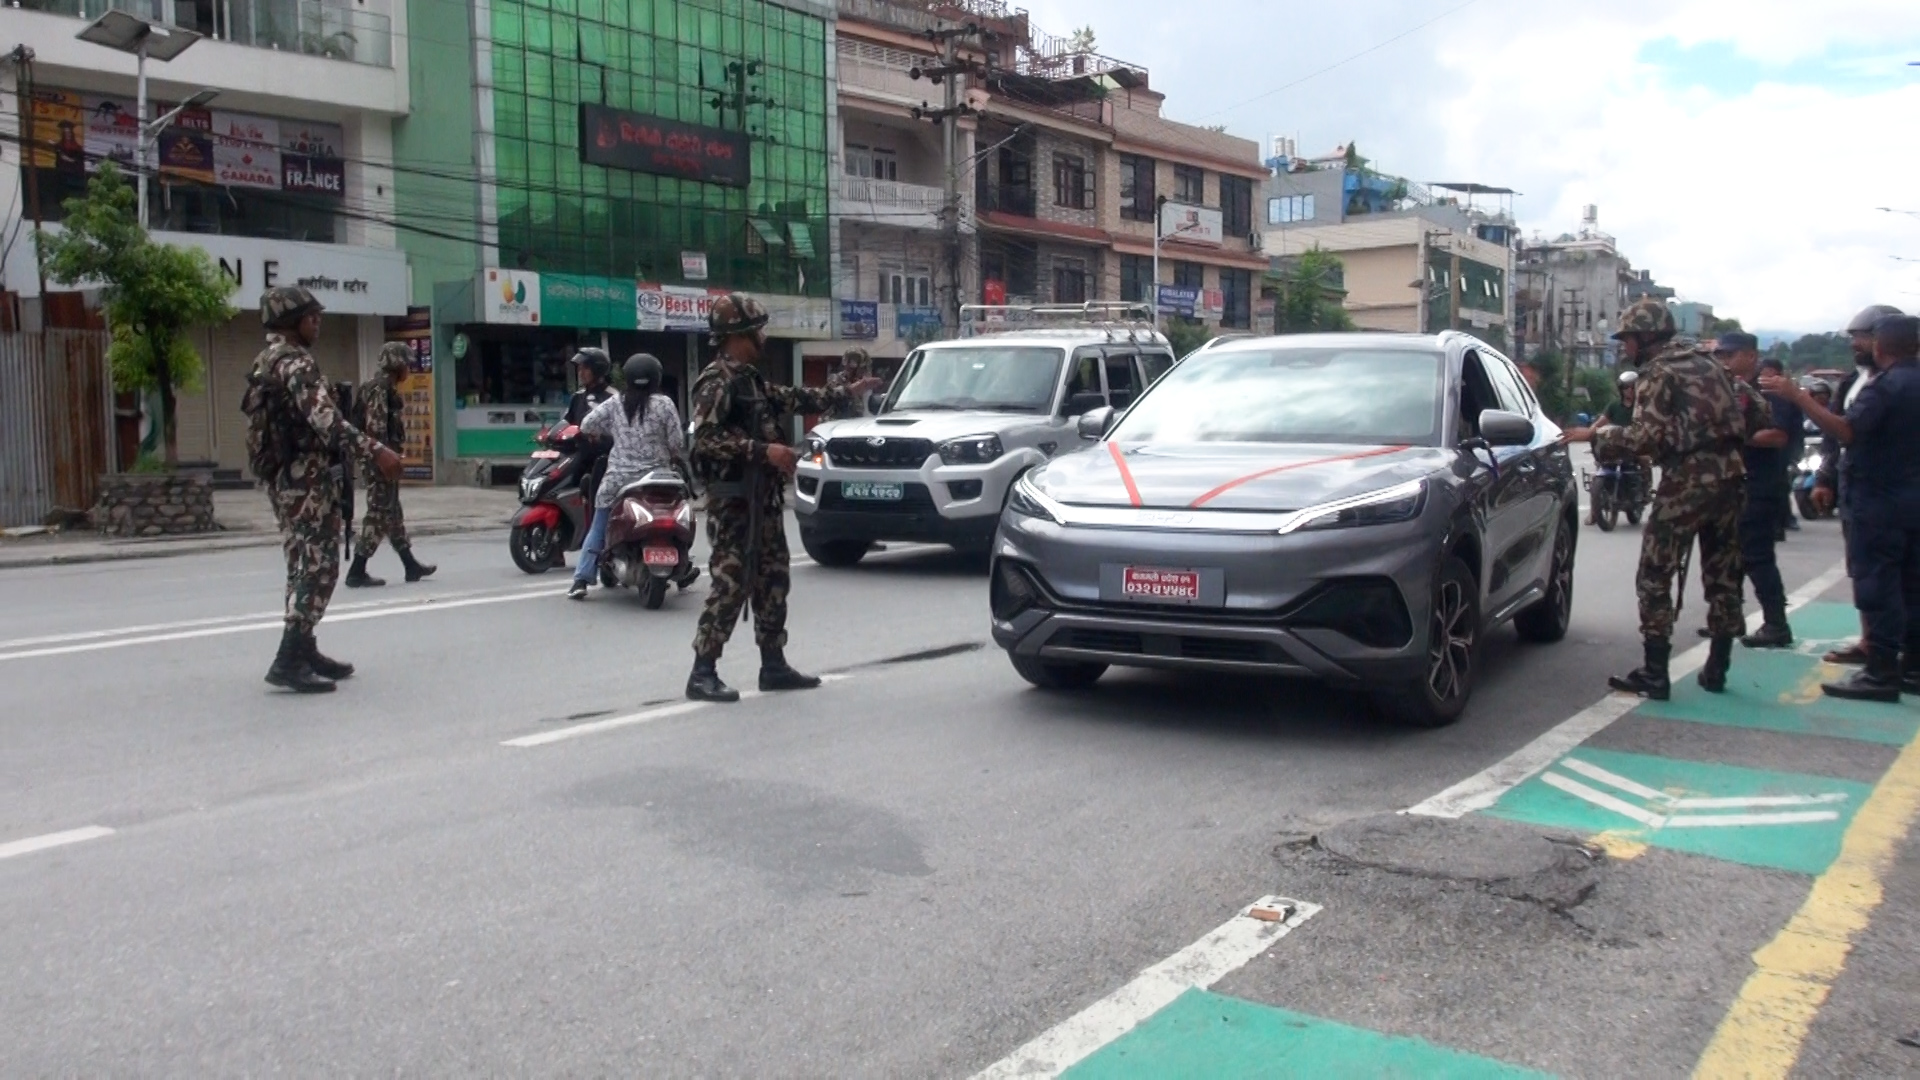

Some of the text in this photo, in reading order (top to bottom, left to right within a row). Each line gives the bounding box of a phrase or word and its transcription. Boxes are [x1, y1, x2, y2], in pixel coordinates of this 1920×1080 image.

[182, 117, 209, 130] IELTS
[221, 170, 275, 186] CANADA
[286, 165, 341, 192] FRANCE
[665, 296, 693, 313] Best
